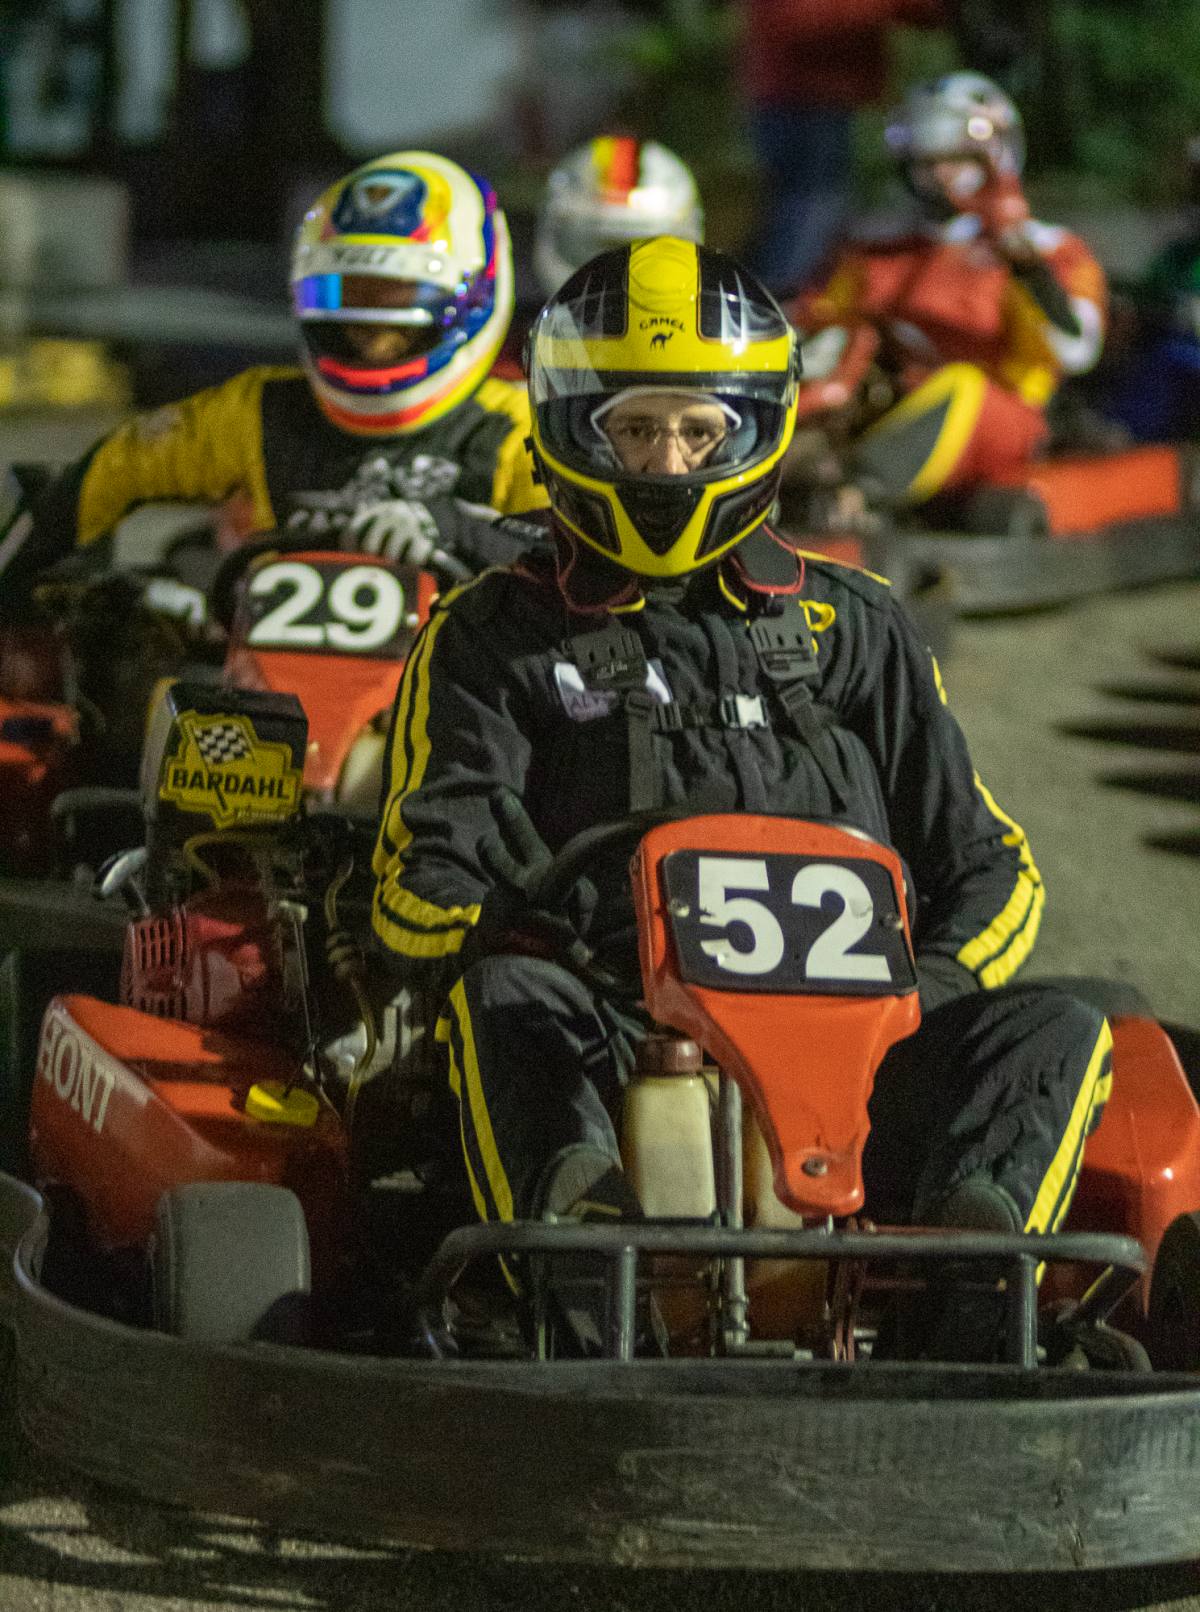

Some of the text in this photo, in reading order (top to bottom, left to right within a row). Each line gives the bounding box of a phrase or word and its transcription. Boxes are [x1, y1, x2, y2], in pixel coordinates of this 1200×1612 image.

[639, 317, 686, 332] CAMEL
[250, 561, 405, 651] 29
[171, 767, 291, 801] BARDAHL
[699, 856, 893, 983] 52
